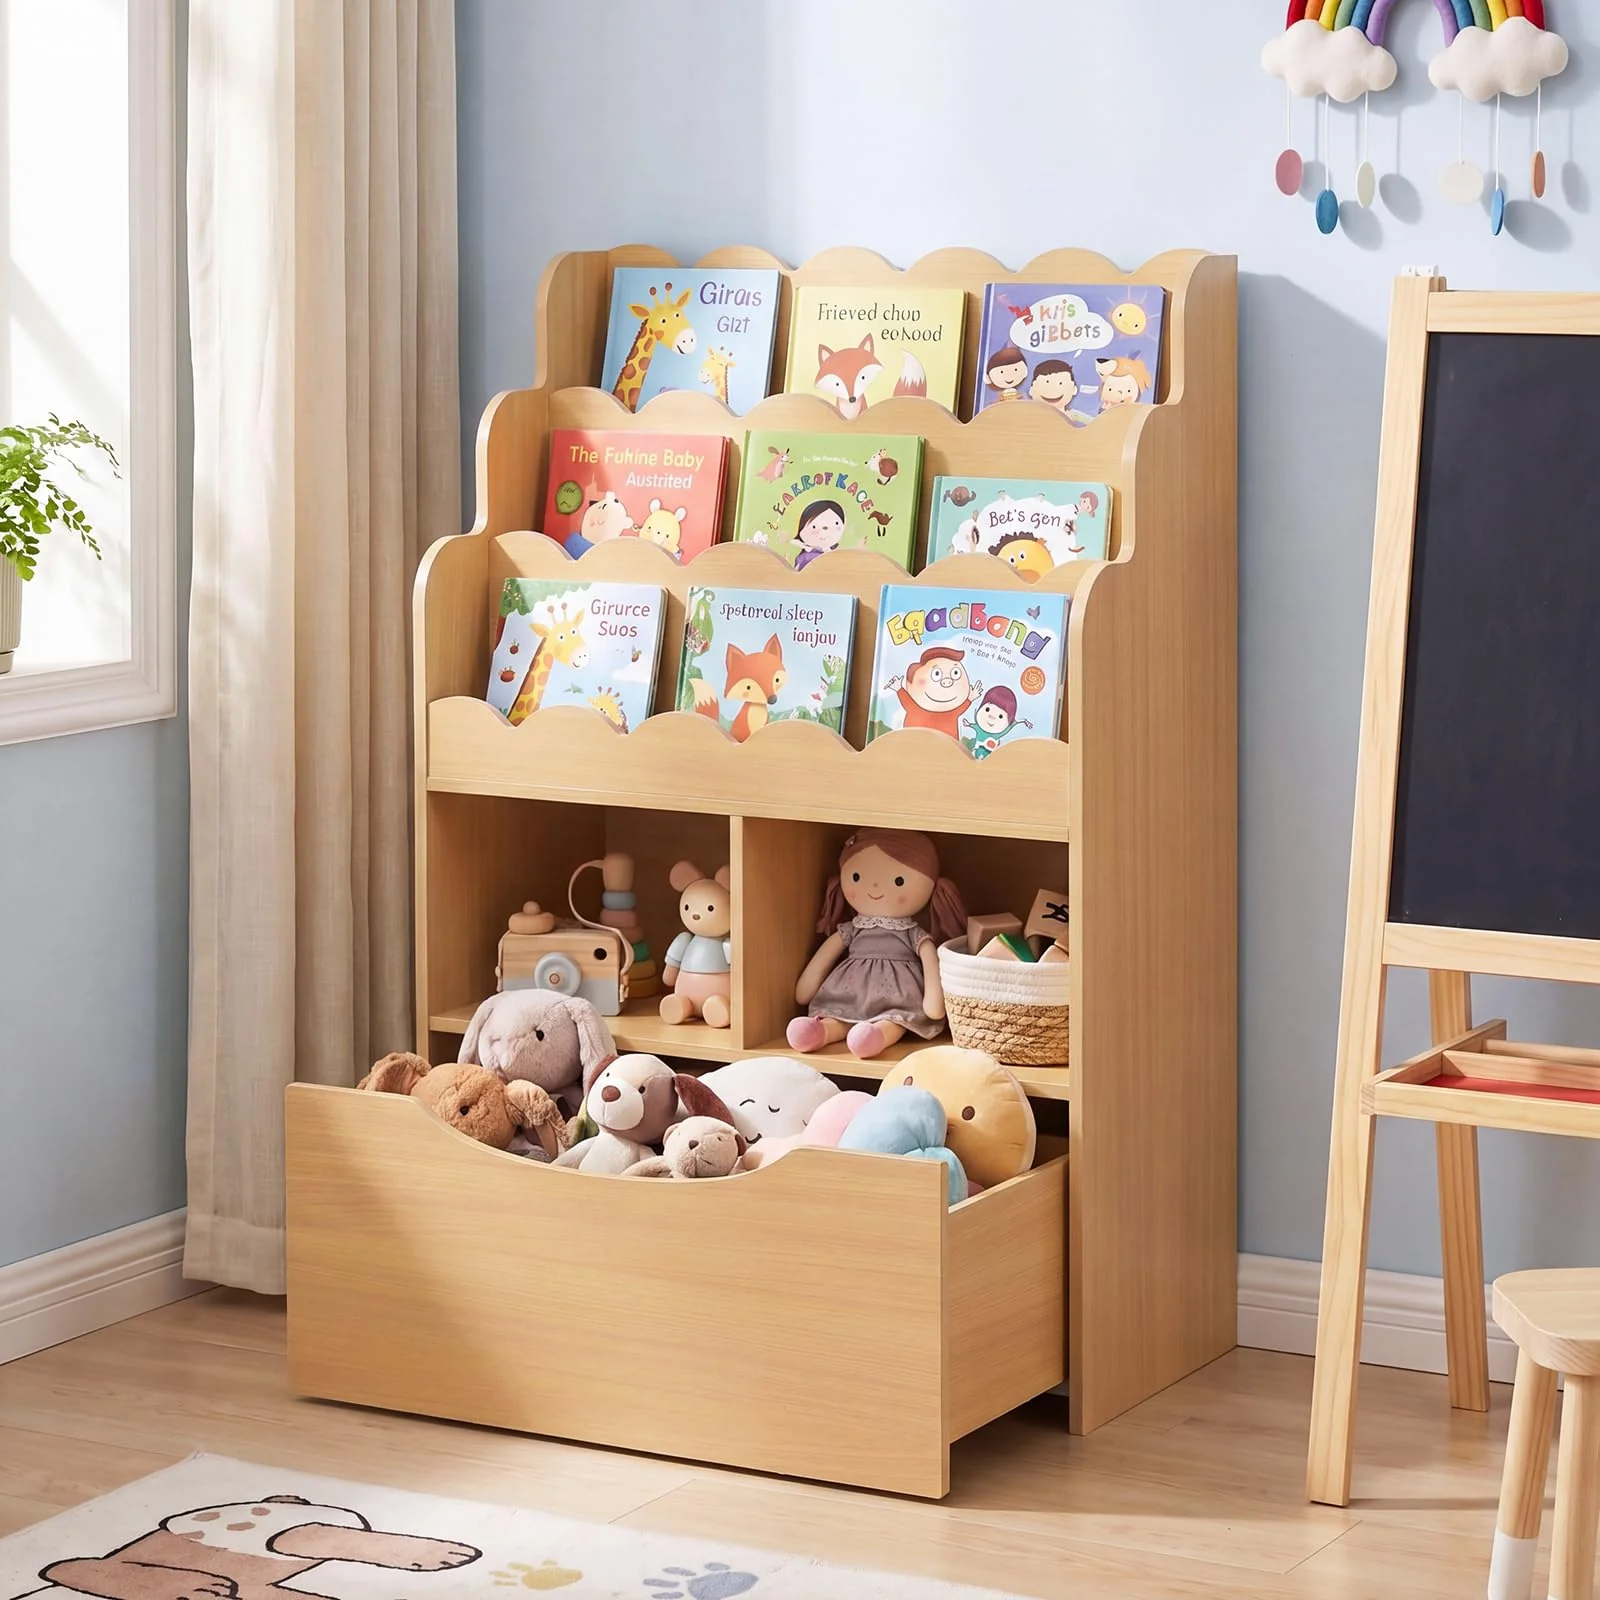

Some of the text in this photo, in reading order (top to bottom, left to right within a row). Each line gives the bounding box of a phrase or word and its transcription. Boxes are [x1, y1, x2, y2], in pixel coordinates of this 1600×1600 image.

[818, 302, 878, 321] Frieved
[569, 445, 599, 464] The
[663, 449, 705, 472] Baby
[625, 471, 693, 489] Austrited
[989, 508, 1026, 528] Bet's
[591, 599, 651, 617] Girurce
[598, 620, 638, 638] Suos
